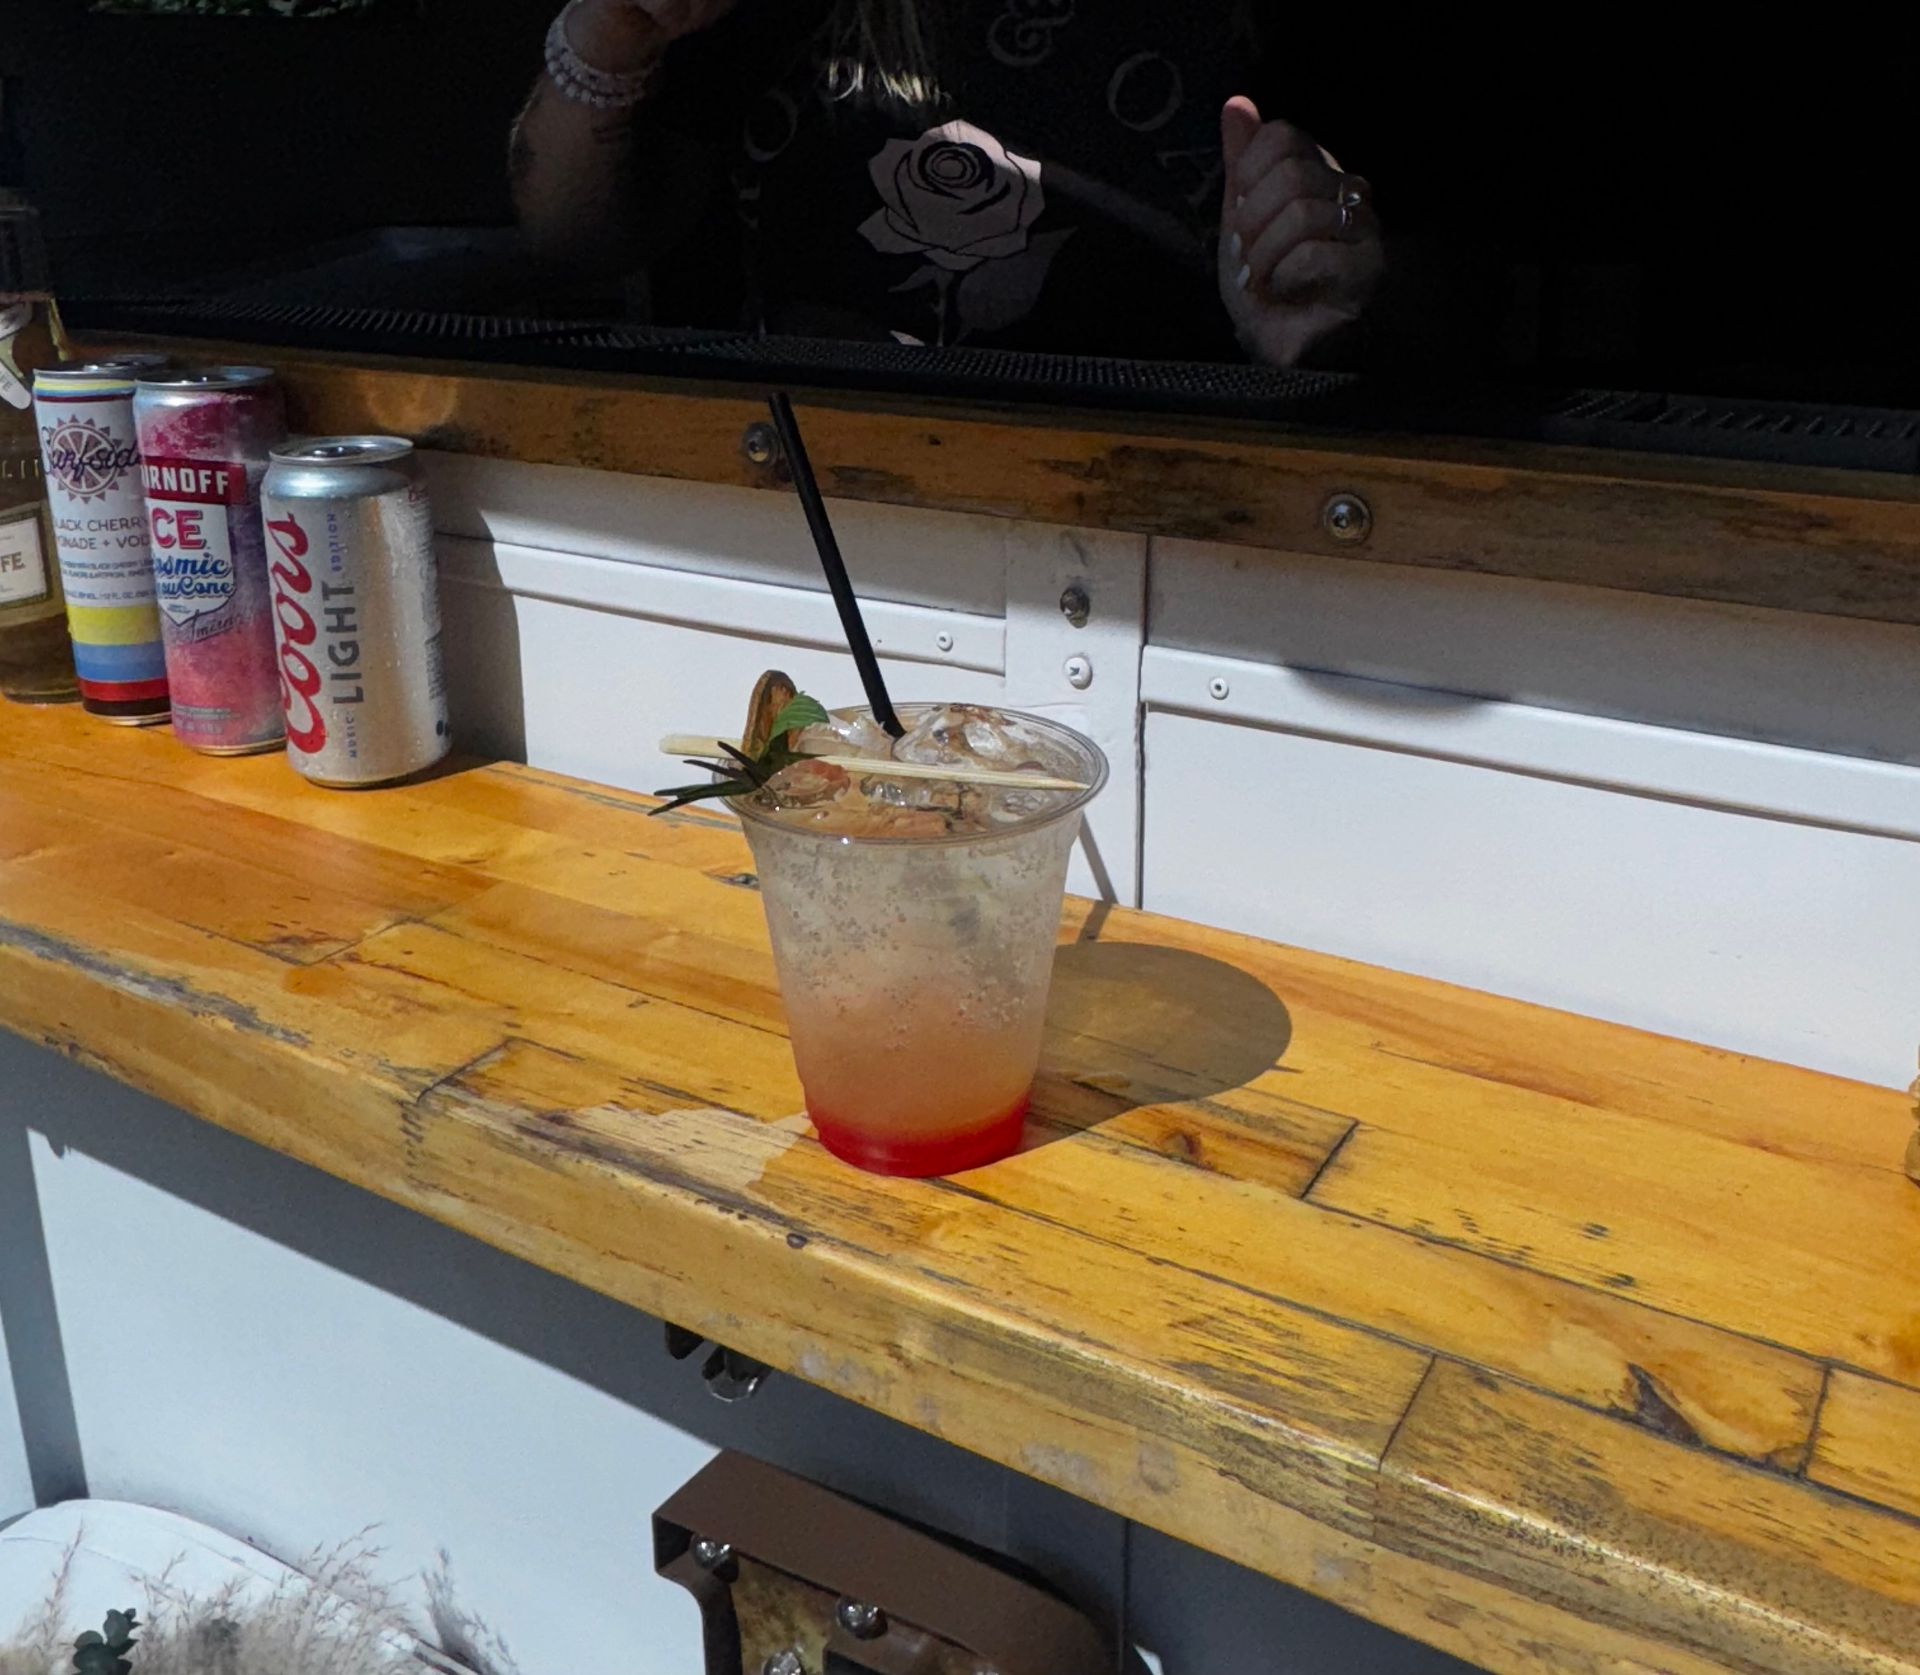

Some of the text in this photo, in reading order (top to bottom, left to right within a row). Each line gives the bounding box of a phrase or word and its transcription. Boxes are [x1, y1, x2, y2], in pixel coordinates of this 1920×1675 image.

[41, 426, 142, 481] Surfsid
[140, 464, 229, 495] IRNOFF
[55, 518, 84, 532] LACK
[57, 535, 97, 550] ONADE
[116, 534, 150, 549] VOD
[152, 506, 207, 550] CE
[326, 512, 342, 573] EDITION
[267, 512, 326, 754] Coors
[322, 580, 364, 705] LIGHT
[345, 716, 357, 759] MUSIC
